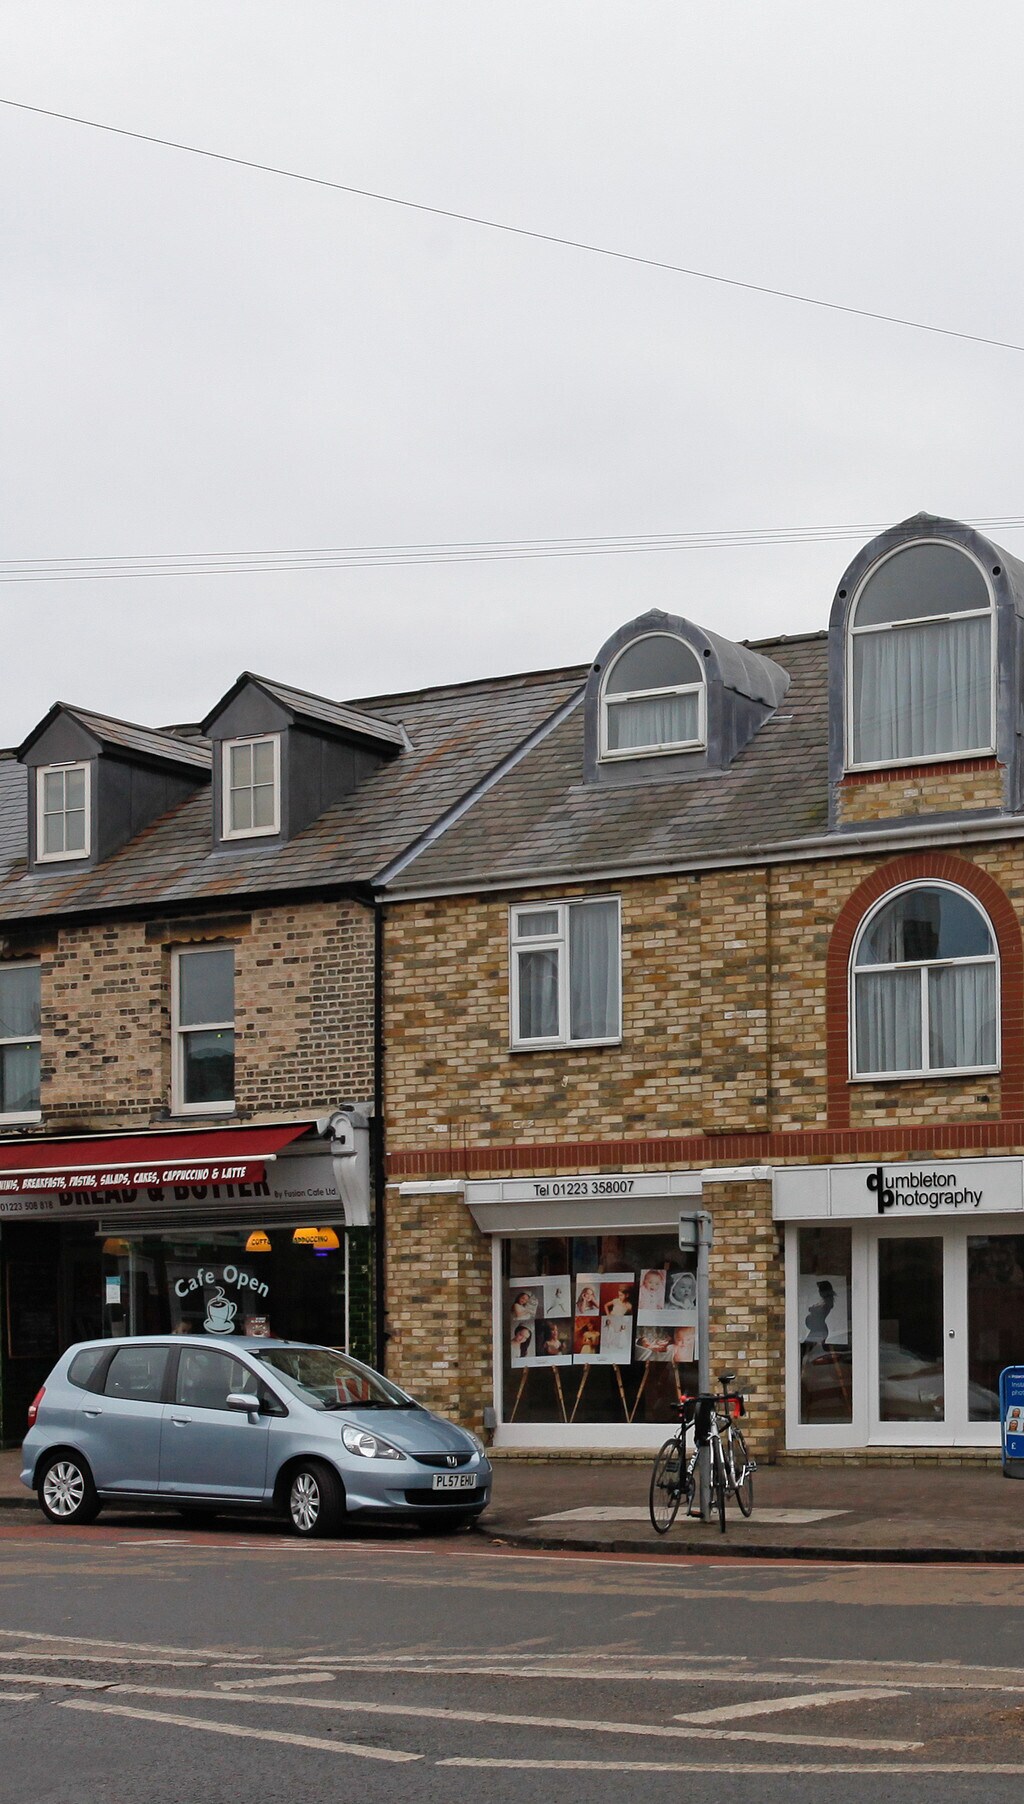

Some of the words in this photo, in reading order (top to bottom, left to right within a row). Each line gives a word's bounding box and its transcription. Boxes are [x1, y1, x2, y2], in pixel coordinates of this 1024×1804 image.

[22, 1176, 67, 1189] BREAKFASTS,
[69, 1174, 98, 1187] PASTAS,
[100, 1173, 131, 1185] SALADS,
[133, 1171, 160, 1184] CAKES,
[162, 1168, 209, 1181] CAPPUCCINO
[211, 1168, 219, 1180] &
[221, 1166, 247, 1179] LATTE
[866, 1167, 957, 1192] dumbleton
[284, 1189, 306, 1198] Fusion
[306, 1188, 324, 1197] Cafe
[533, 1184, 549, 1196] Tel
[552, 1182, 588, 1196] 01223
[591, 1180, 635, 1194] 358007
[0, 1201, 22, 1211] 01223
[878, 1186, 983, 1213] photography
[174, 1268, 215, 1298] Cafe
[222, 1264, 269, 1298] Open
[436, 1475, 459, 1487] PL57
[460, 1475, 475, 1486] EHU
